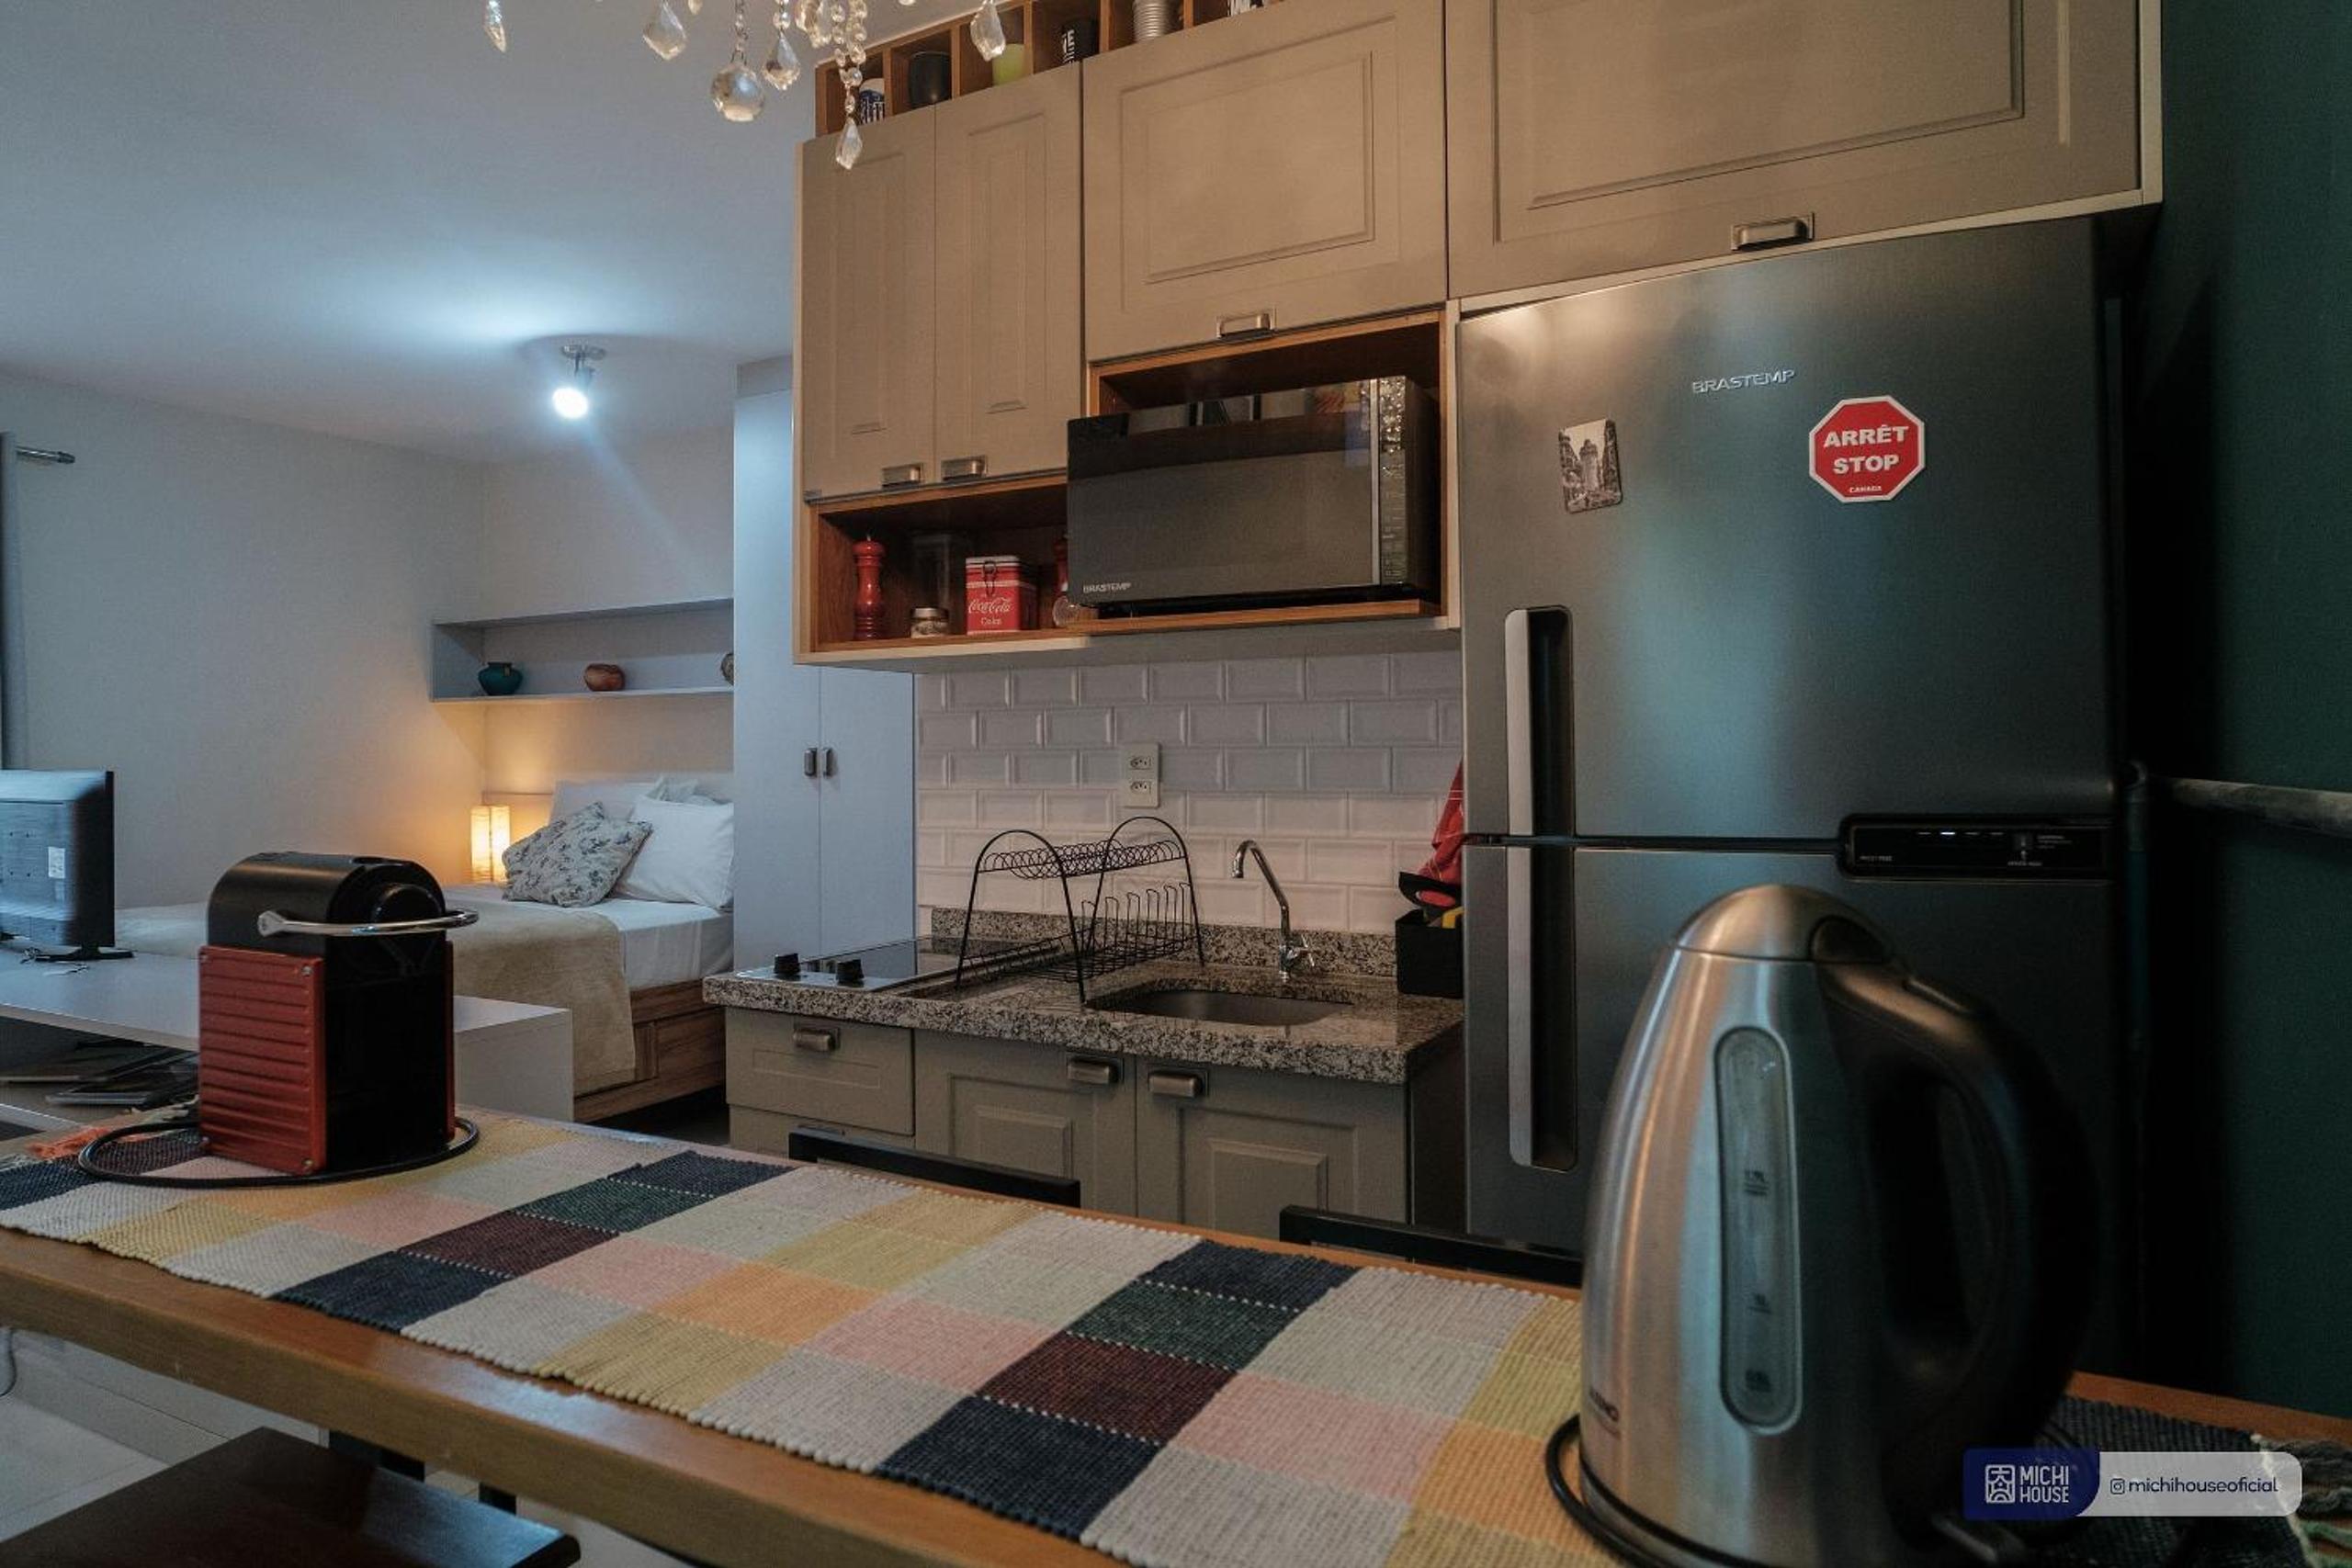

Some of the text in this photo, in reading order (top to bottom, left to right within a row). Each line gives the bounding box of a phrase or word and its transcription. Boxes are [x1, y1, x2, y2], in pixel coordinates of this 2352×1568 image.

[1692, 369, 1795, 393] BRASTEMP
[1823, 424, 1909, 448] ARRÊT
[1833, 454, 1900, 475] STOP
[1848, 485, 1883, 493] CANADA
